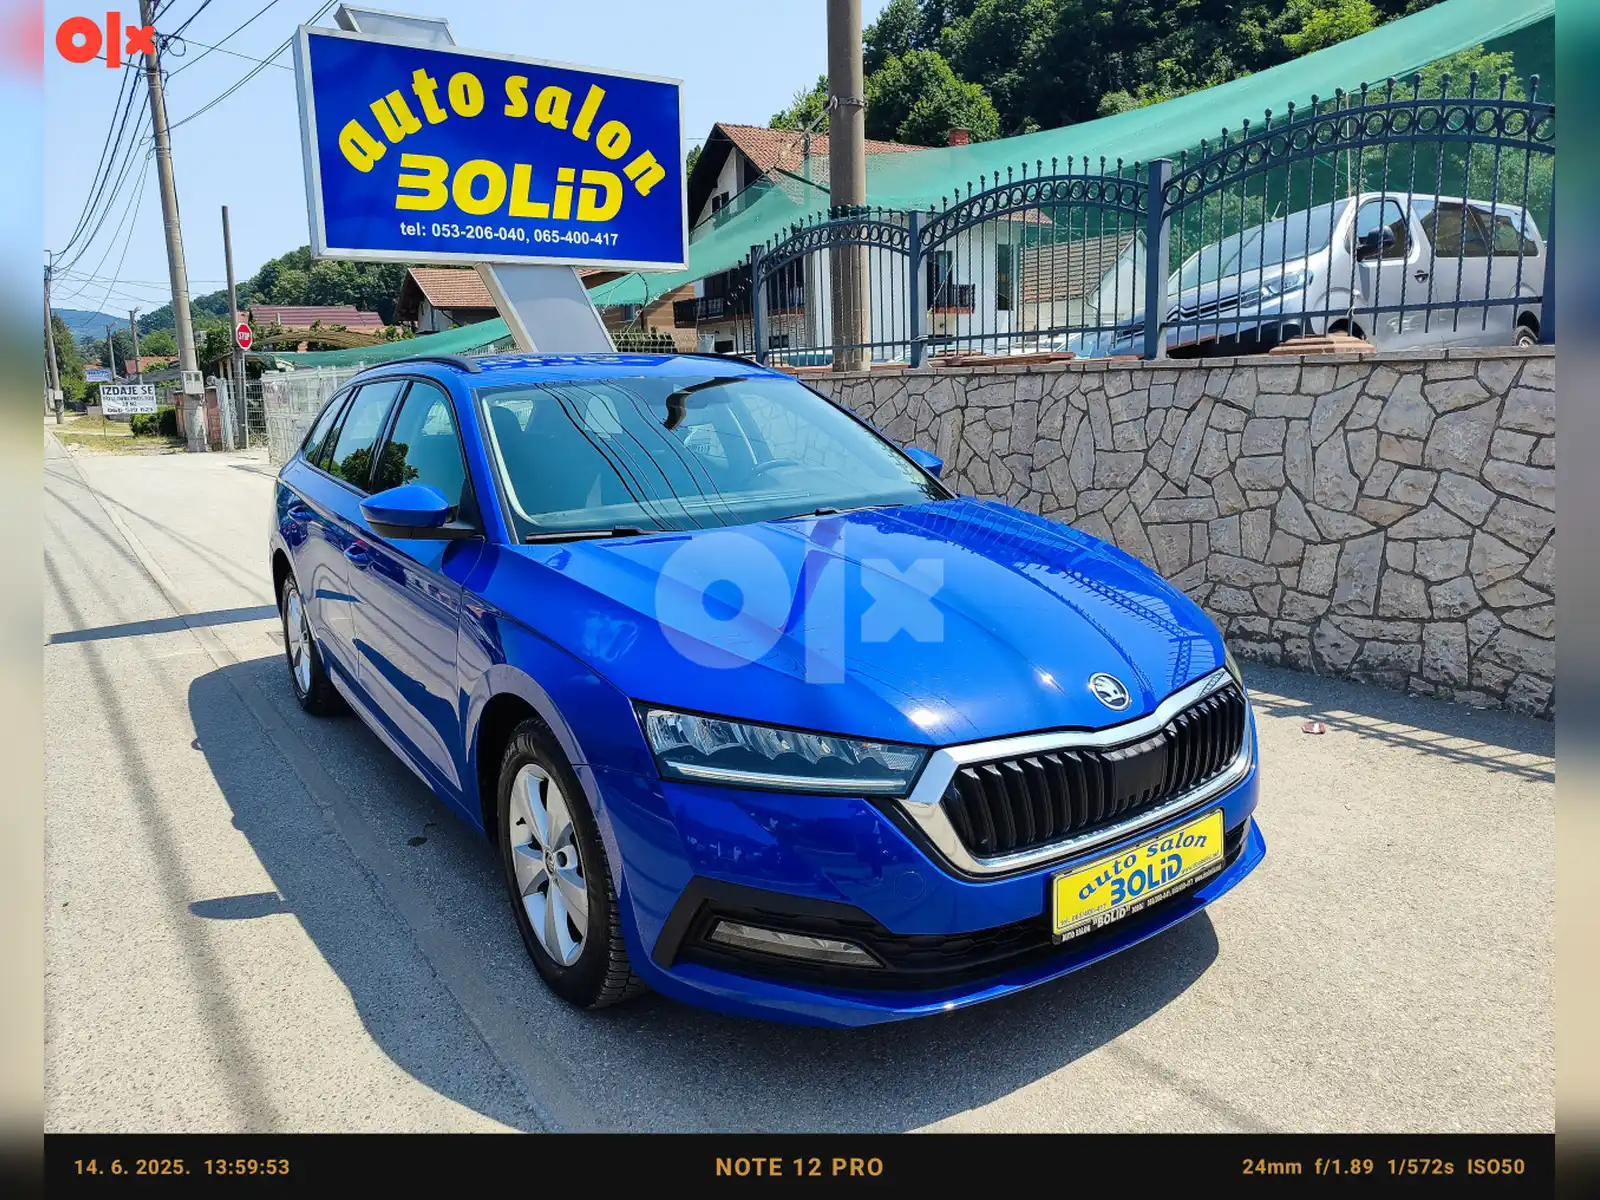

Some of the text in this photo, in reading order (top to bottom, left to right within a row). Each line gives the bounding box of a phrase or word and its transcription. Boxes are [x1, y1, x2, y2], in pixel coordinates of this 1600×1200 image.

[338, 68, 666, 197] auto salon
[400, 221, 619, 246] tel: 053-206-040, 065-400-417
[238, 331, 250, 341] STOP
[101, 385, 154, 396] IZDAJE SE
[1078, 853, 1137, 900] auto
[1146, 832, 1207, 858] salon
